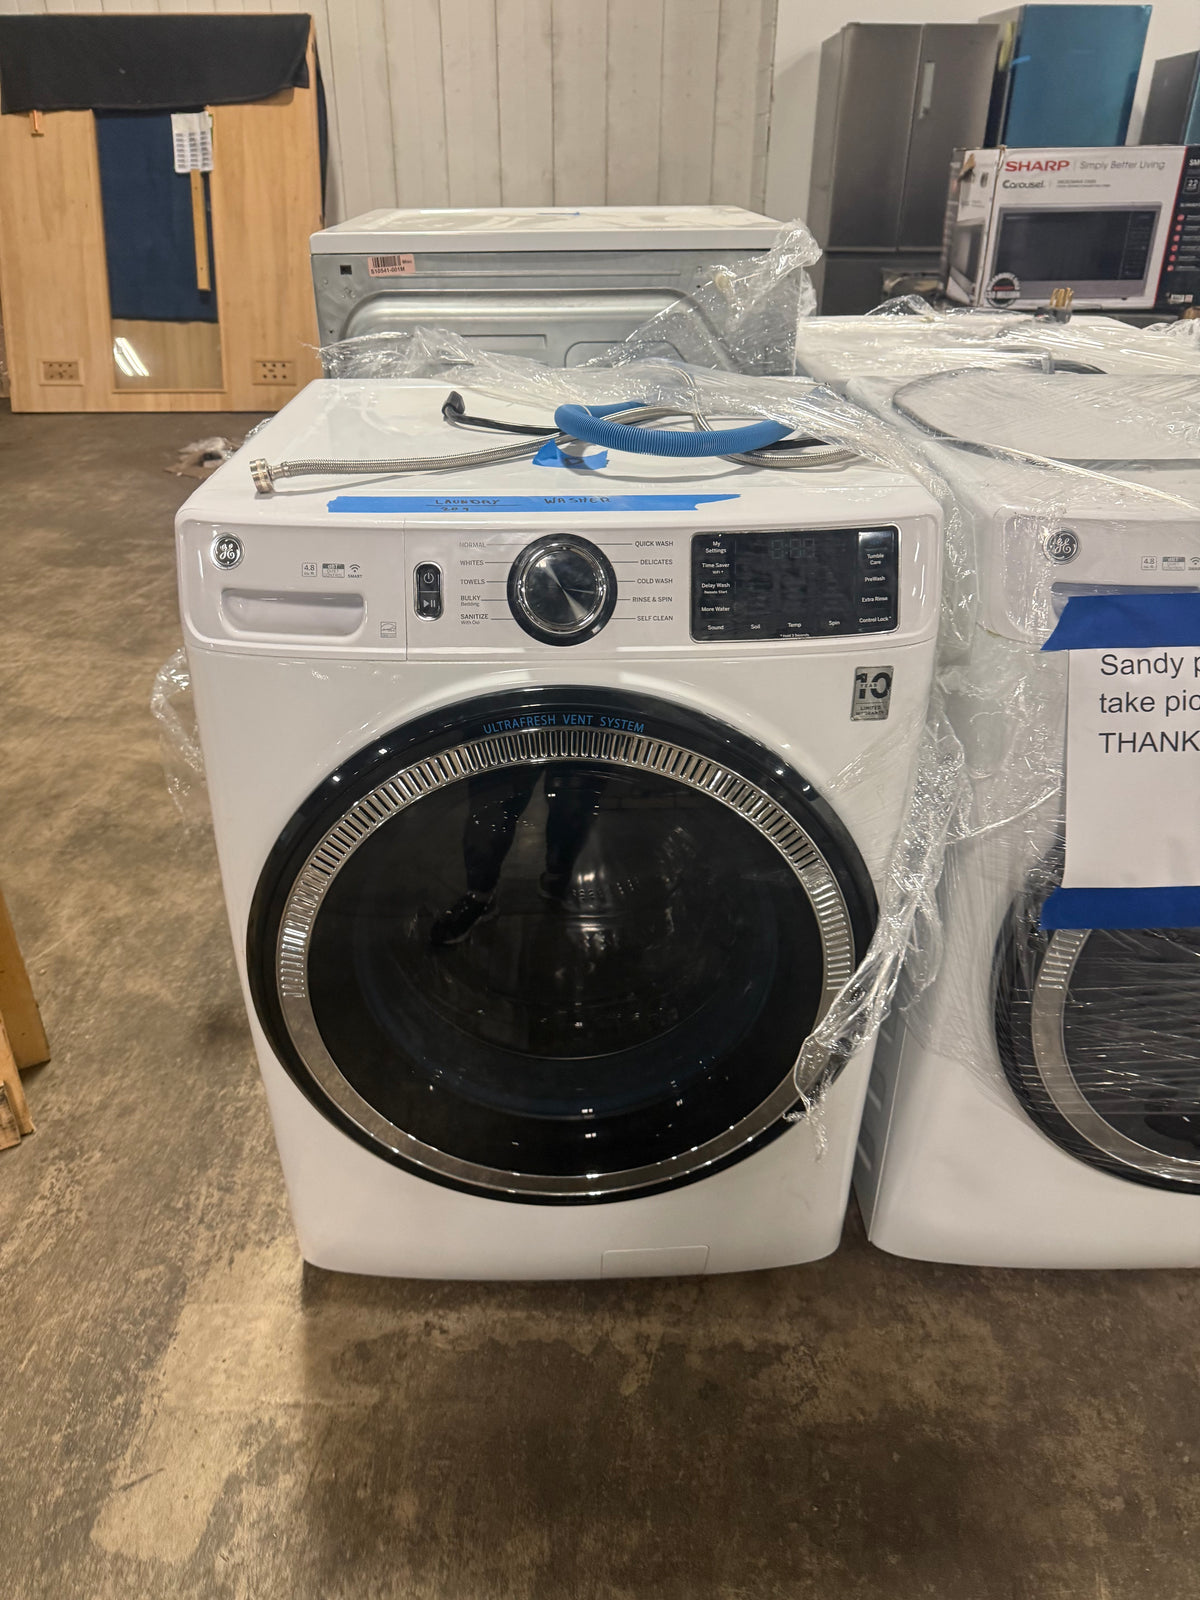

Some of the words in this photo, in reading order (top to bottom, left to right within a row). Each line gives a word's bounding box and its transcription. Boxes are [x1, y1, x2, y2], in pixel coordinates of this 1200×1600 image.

[1004, 160, 1070, 172] SHARP
[1079, 160, 1109, 171] Simply
[1110, 160, 1137, 170] Better
[1139, 160, 1166, 171] Living
[1002, 180, 1045, 189] Carousel
[544, 496, 611, 504] WASHER
[1100, 652, 1184, 679] Sandy
[856, 672, 892, 699] 10
[1099, 691, 1155, 713] take
[1166, 689, 1200, 717] pic
[483, 714, 556, 734] ULTRAFRESH
[562, 714, 594, 726] VENT
[600, 716, 645, 733] SYSTEM
[1098, 730, 1200, 753] THANK
